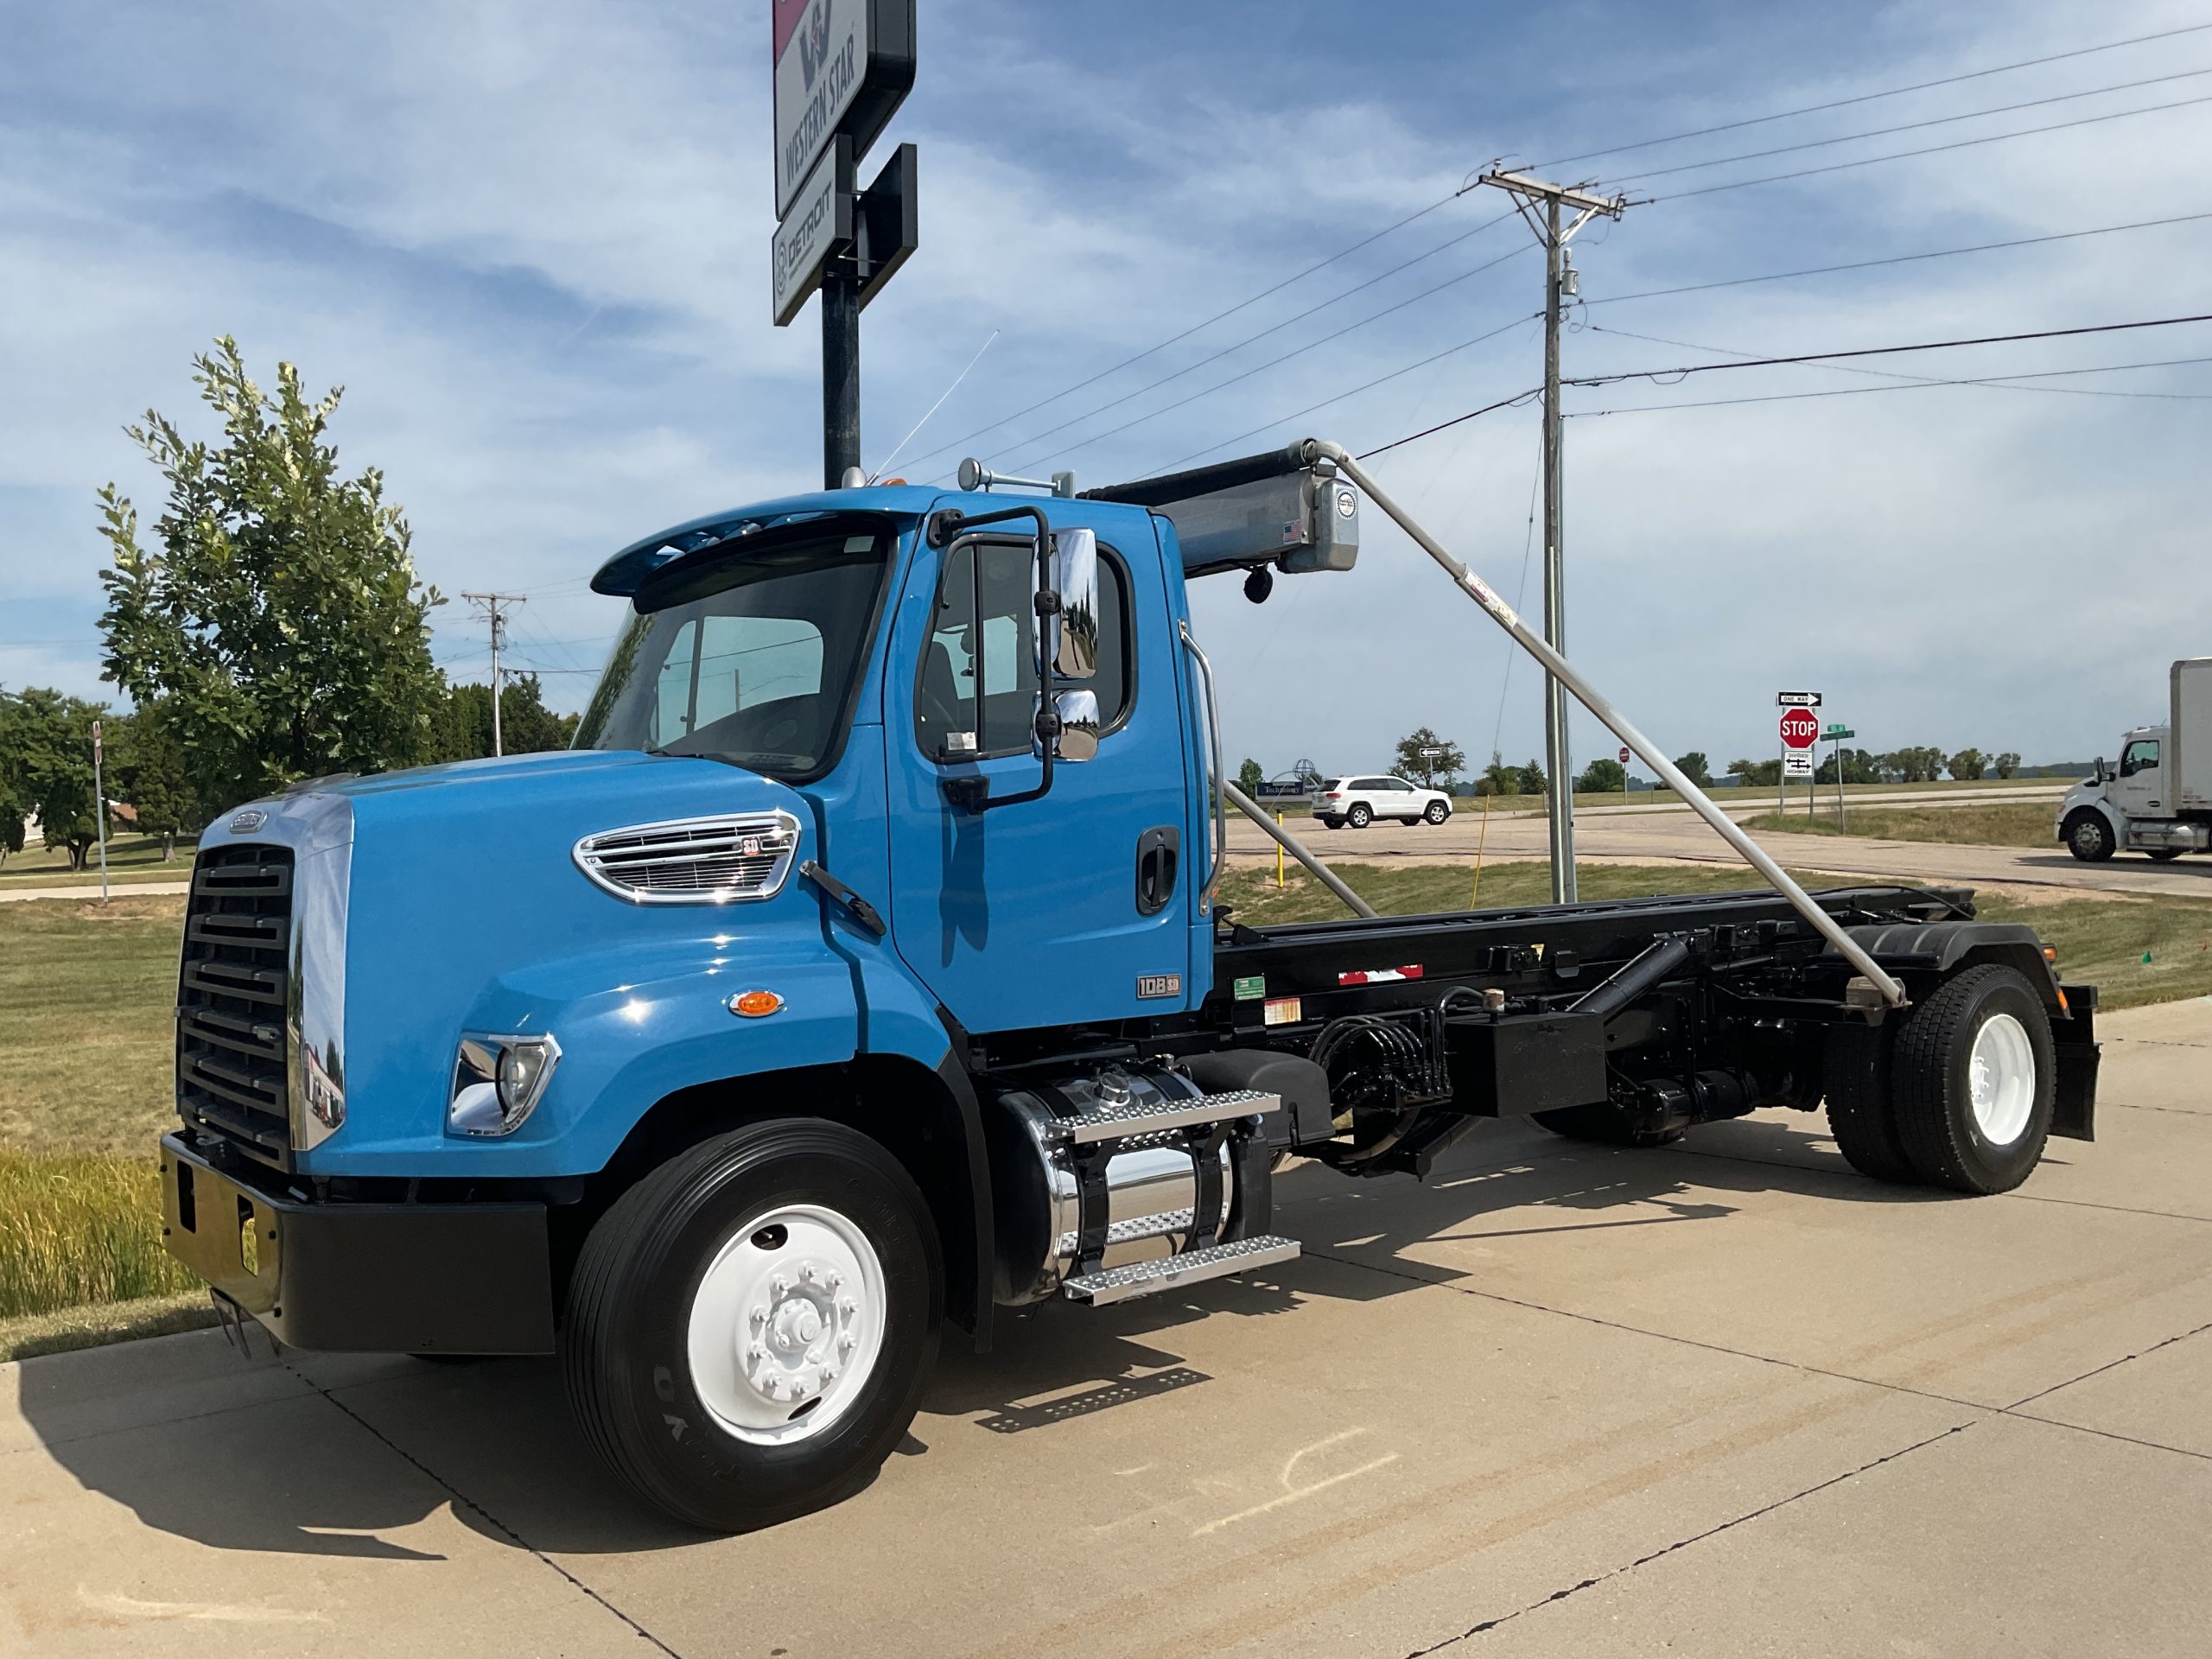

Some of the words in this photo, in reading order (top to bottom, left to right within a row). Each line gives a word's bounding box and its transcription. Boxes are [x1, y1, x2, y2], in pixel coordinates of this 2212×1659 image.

[785, 75, 827, 187] WESTERN
[829, 33, 855, 118] STAR
[787, 180, 833, 262] DETROIT
[1782, 721, 1816, 736] STOP
[743, 839, 759, 852] SD
[1140, 976, 1166, 996] 108
